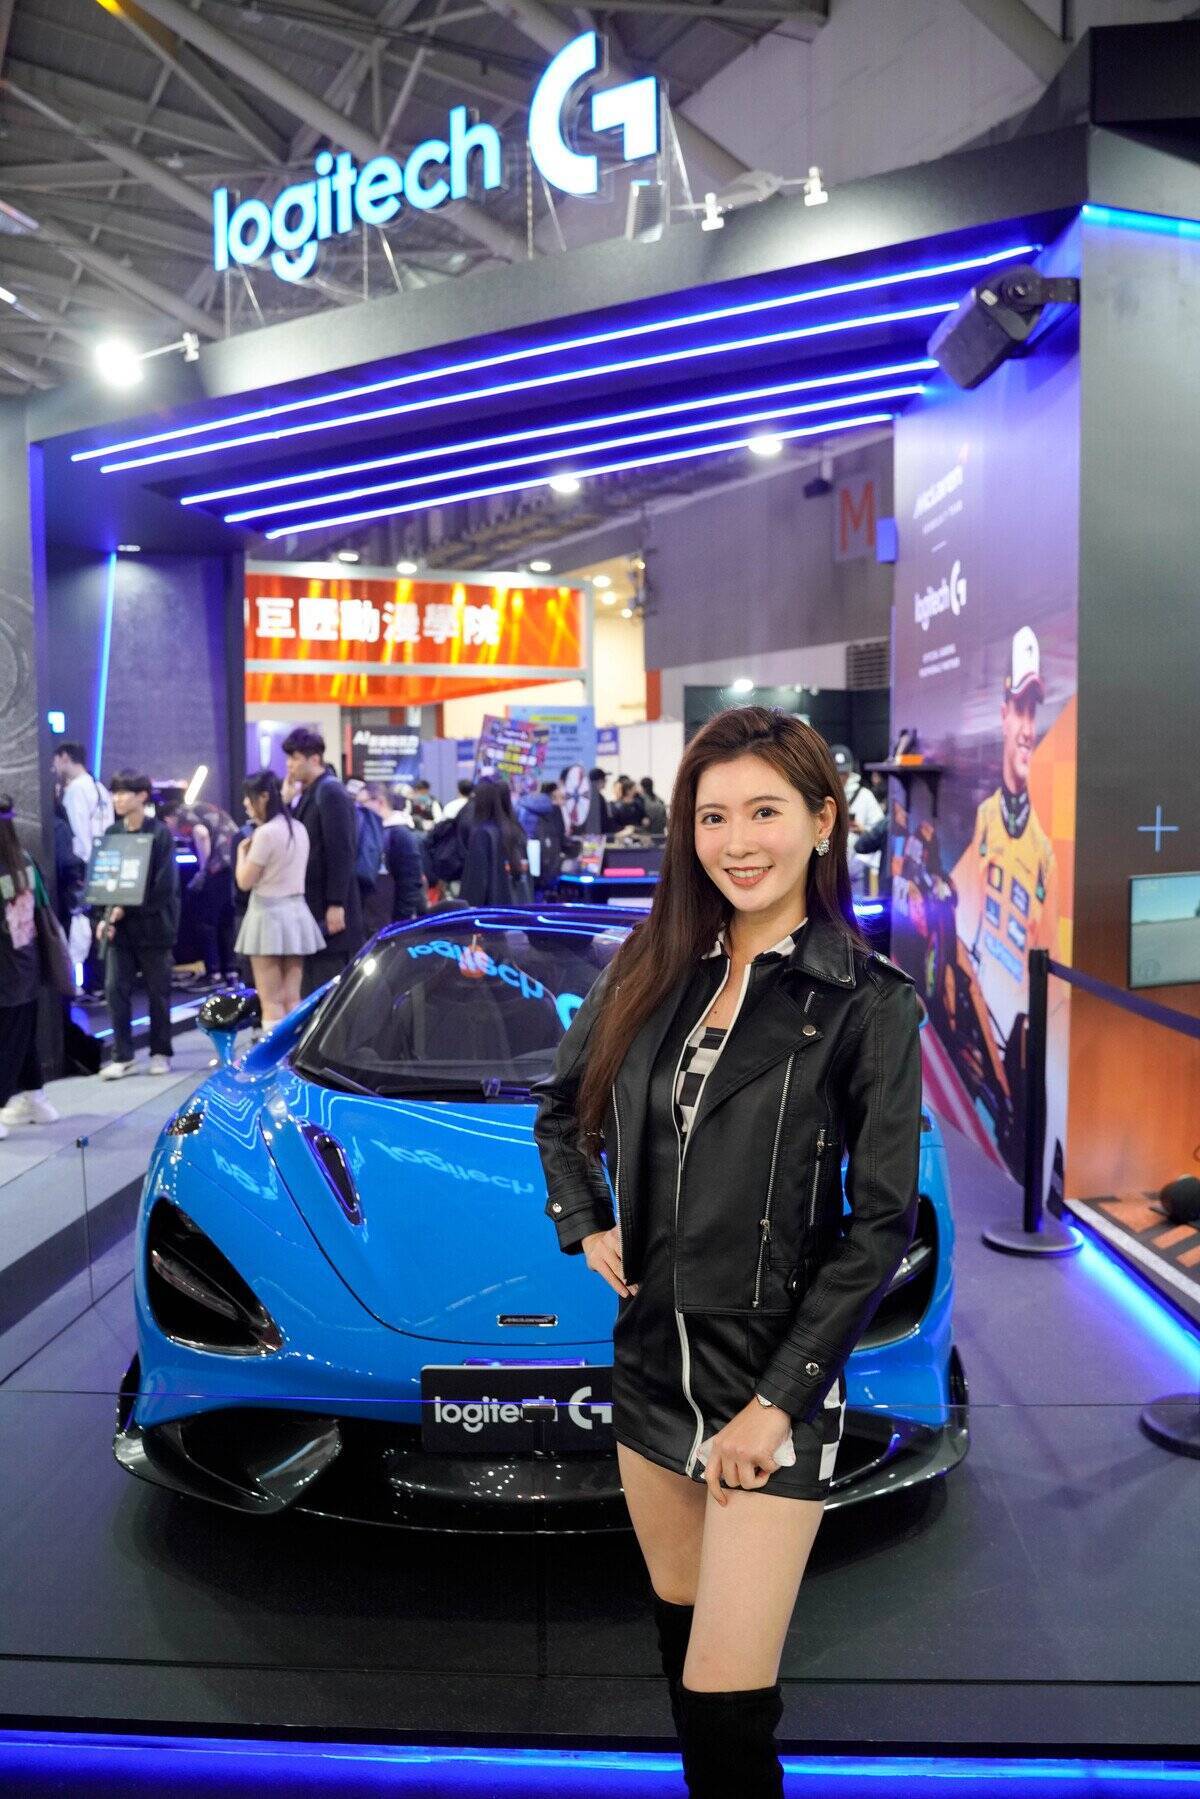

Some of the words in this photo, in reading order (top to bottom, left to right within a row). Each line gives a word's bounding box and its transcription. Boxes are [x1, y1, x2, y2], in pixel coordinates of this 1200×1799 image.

[213, 105, 501, 283] logitech
[528, 30, 657, 195] G
[840, 480, 875, 555] M
[434, 1395, 558, 1433] logite
[568, 1386, 613, 1430] G
